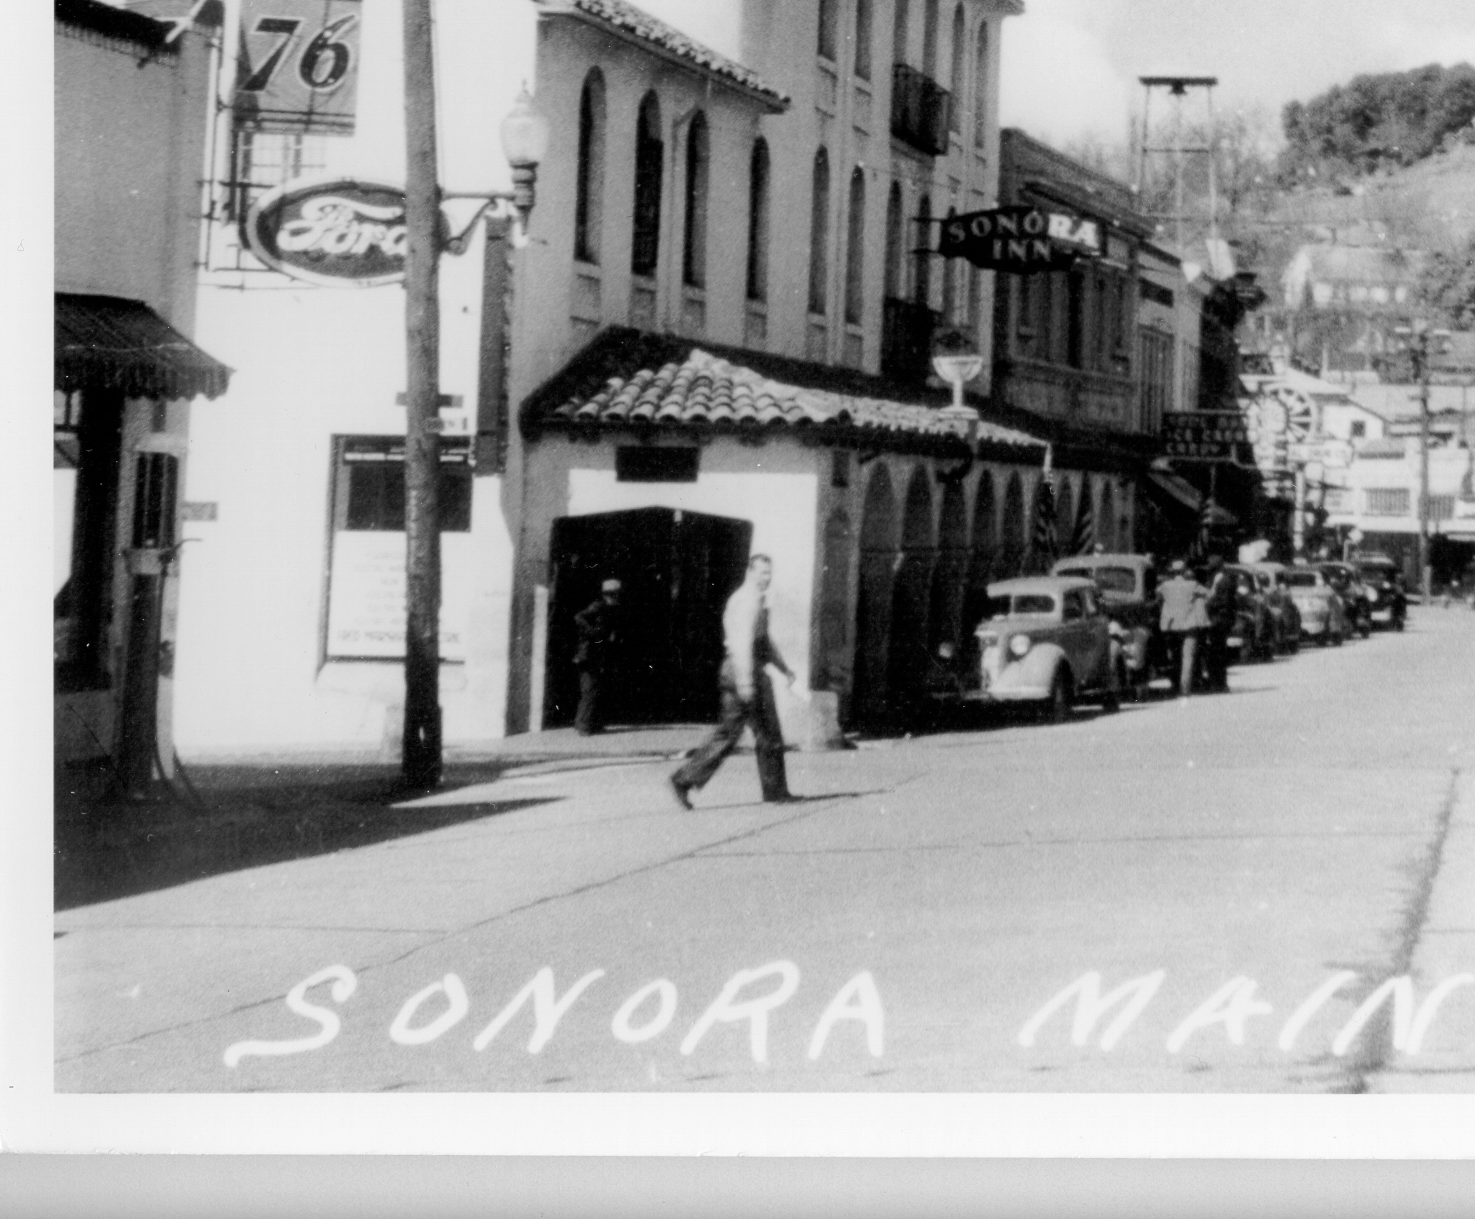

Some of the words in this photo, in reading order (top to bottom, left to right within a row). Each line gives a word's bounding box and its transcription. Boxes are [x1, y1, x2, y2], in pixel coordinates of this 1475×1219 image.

[241, 15, 357, 91] 76
[949, 210, 1099, 249] SONORA
[992, 238, 1051, 262] INN
